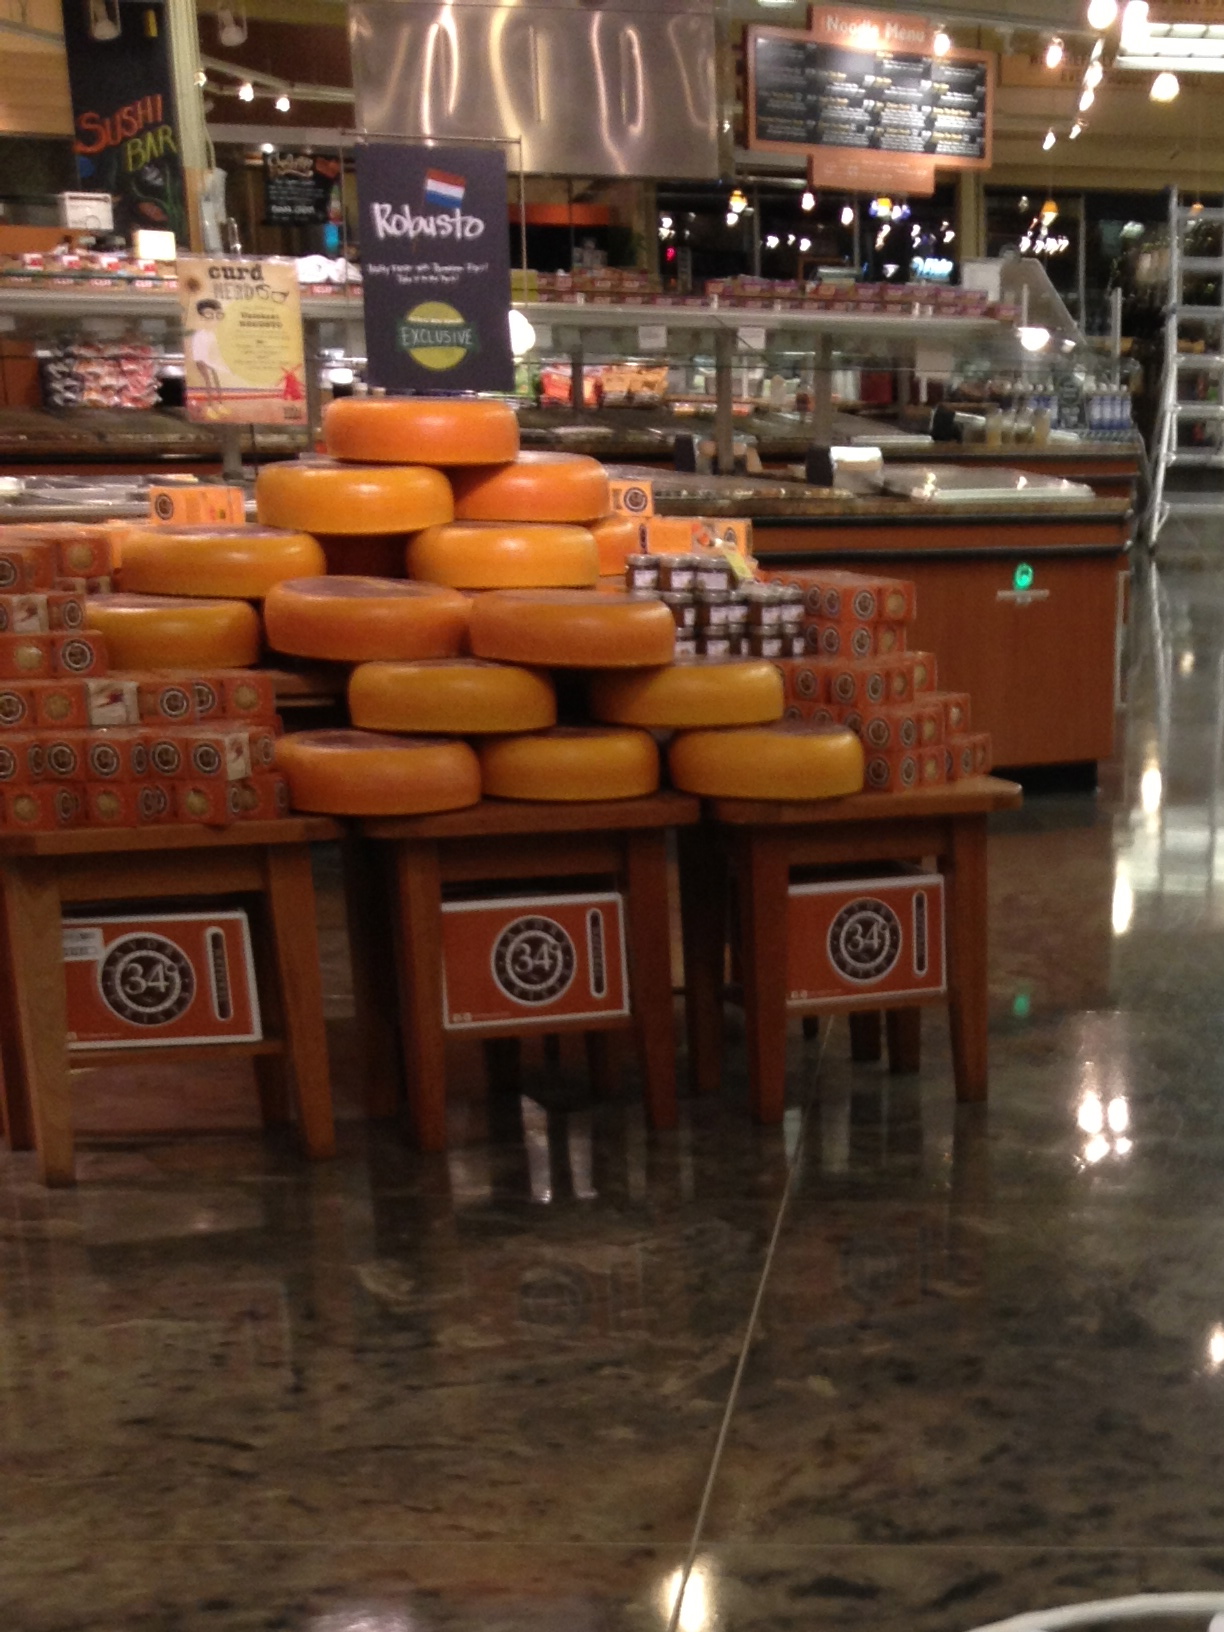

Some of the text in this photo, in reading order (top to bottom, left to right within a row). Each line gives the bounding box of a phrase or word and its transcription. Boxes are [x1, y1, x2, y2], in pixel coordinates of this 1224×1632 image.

[885, 22, 926, 43] Menu
[72, 94, 163, 155] SUSHI
[126, 124, 179, 172] BAR
[371, 202, 486, 240] Robusto
[208, 264, 264, 281] curd
[213, 282, 255, 300] NERD
[401, 326, 474, 347] EXCLUSIVE
